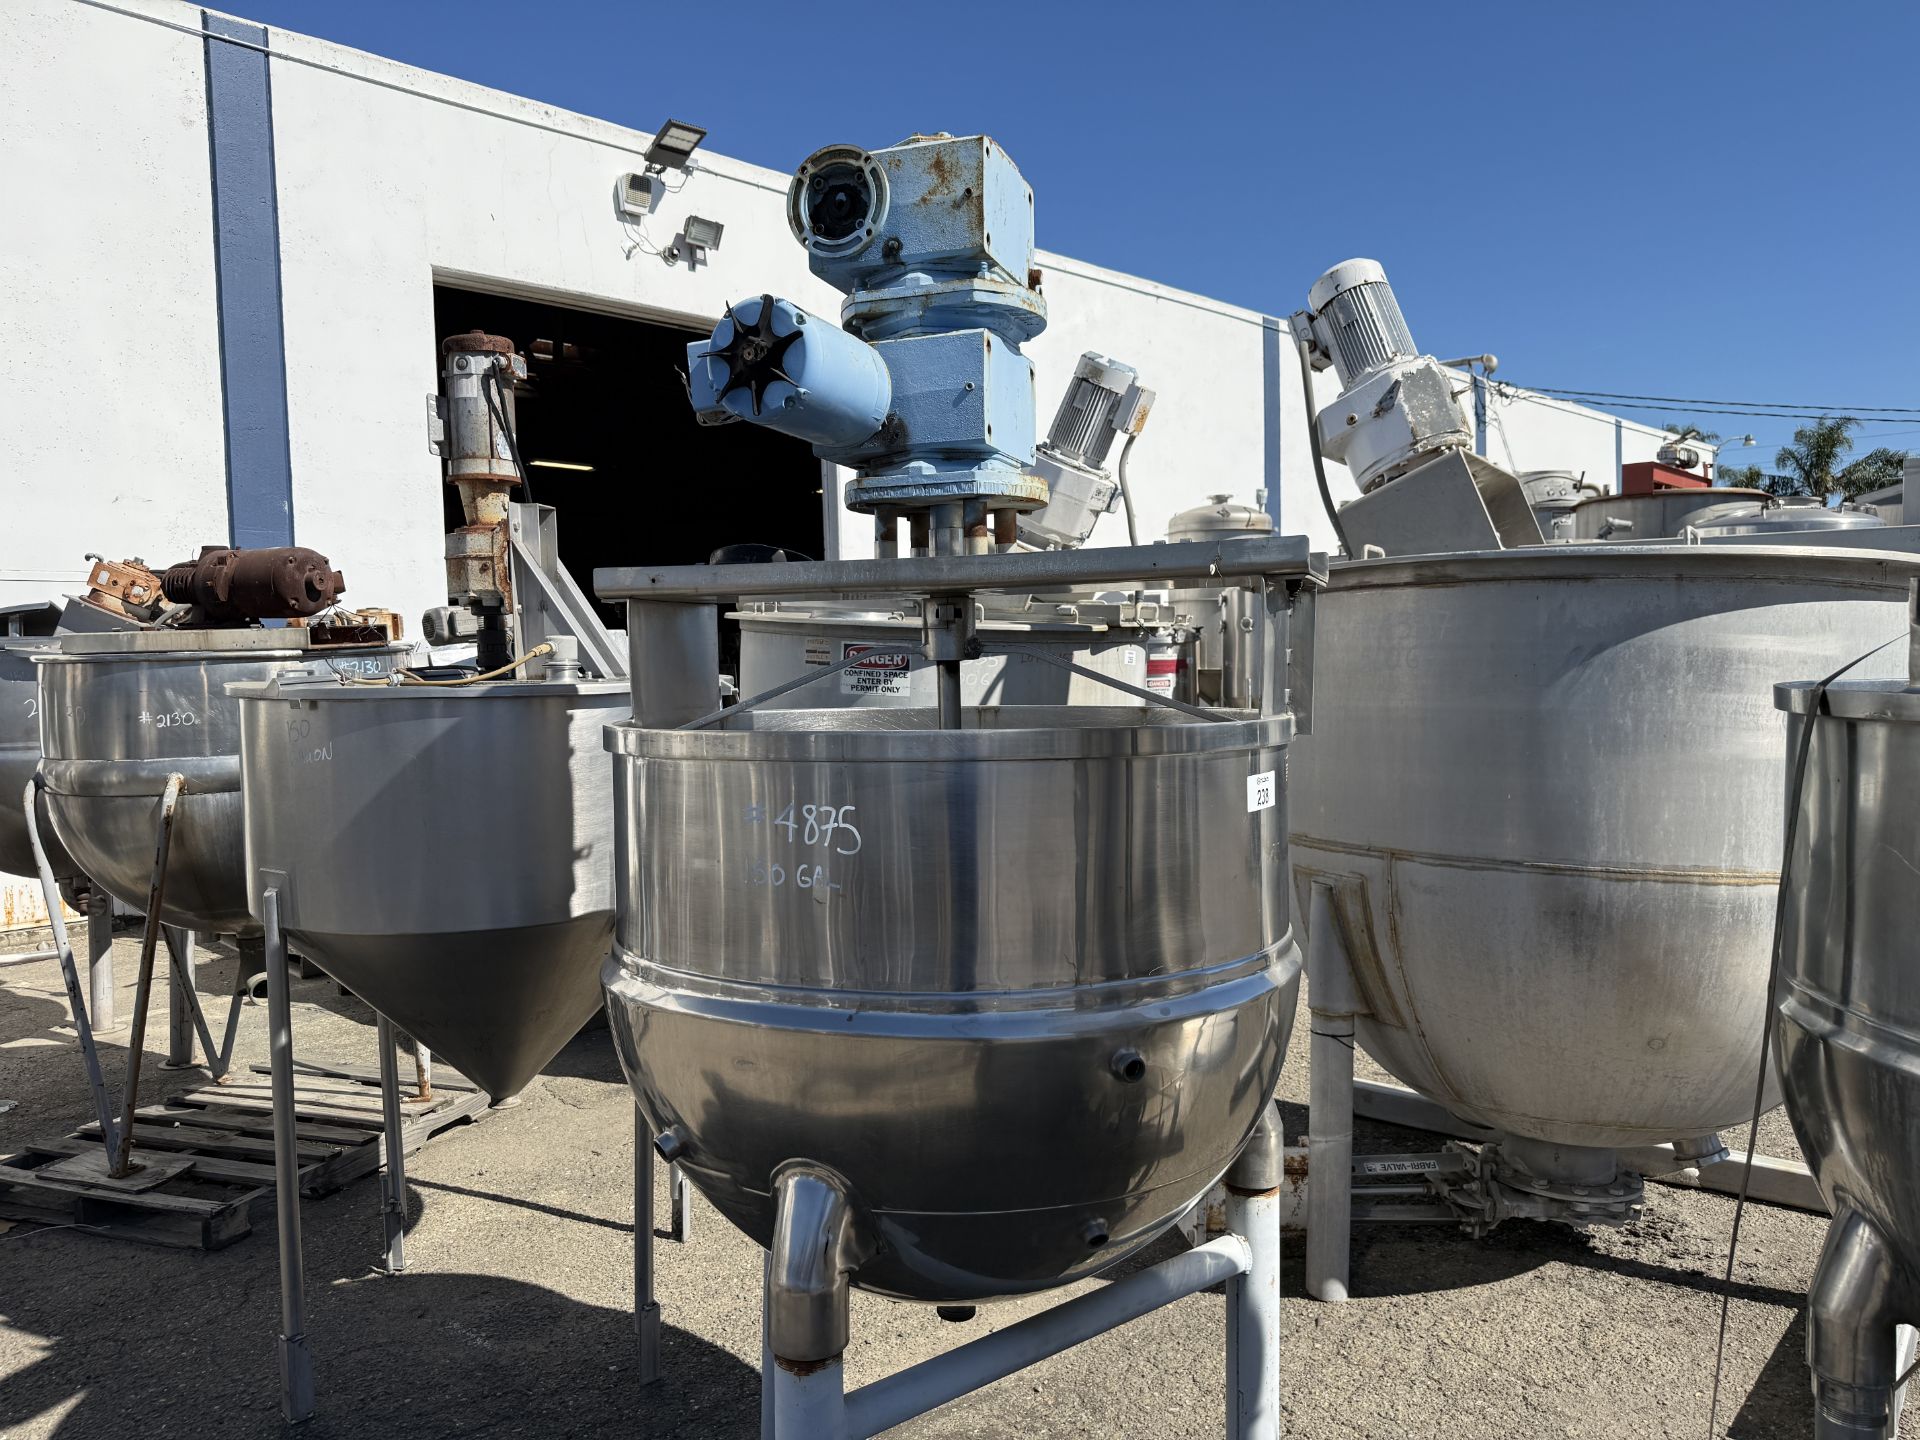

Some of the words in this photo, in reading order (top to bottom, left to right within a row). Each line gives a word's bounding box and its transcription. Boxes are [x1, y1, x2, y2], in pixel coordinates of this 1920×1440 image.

[849, 650, 903, 665] DNGER
[844, 669, 881, 678] CONFINED
[883, 671, 909, 679] SPACE
[883, 678, 894, 686] BY
[881, 686, 901, 694] ONLY
[1380, 1161, 1438, 1172] FABRI-VALVE
